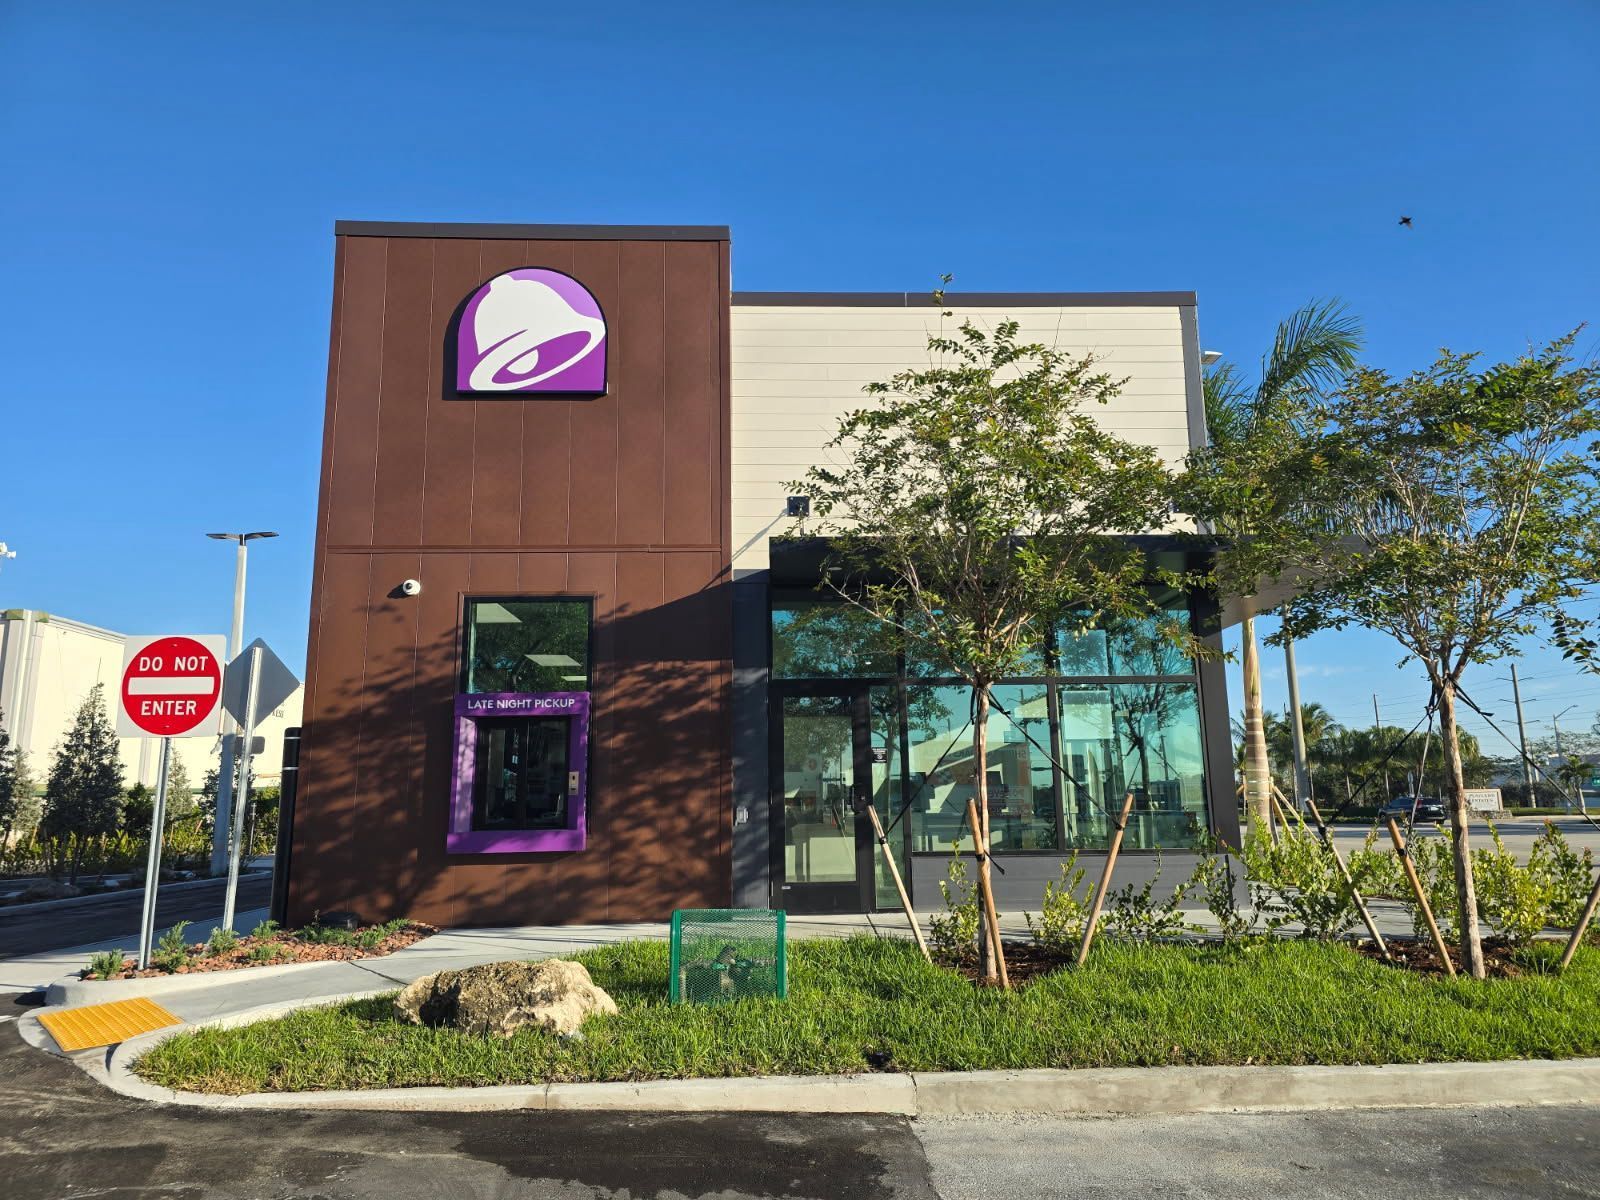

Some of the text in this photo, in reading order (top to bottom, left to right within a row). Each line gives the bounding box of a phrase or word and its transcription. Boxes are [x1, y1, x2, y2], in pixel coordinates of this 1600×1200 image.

[139, 655, 209, 672] DO NOT
[141, 700, 197, 716] ENTER
[467, 698, 575, 709] LATE NIGHT PICKUP
